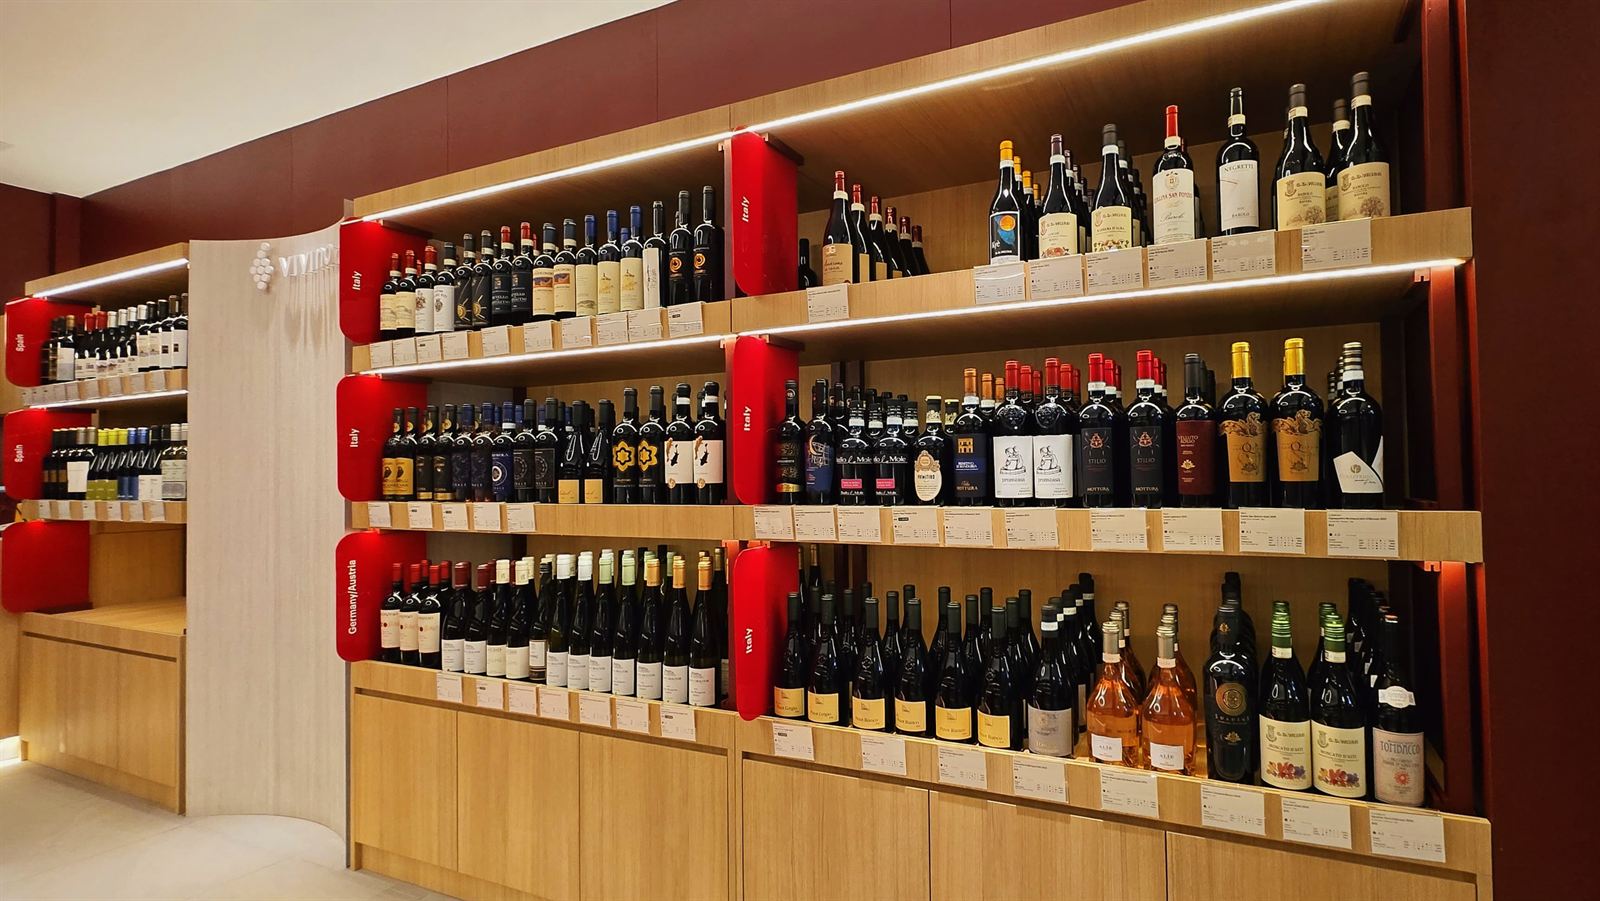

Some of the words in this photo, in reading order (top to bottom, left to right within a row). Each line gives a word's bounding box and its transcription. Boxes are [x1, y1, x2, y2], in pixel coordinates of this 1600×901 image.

[741, 196, 750, 222] Italy
[352, 270, 362, 291] Italy
[15, 334, 26, 352] Spain
[743, 406, 752, 431] Italy
[349, 428, 360, 448] Italy
[14, 444, 24, 463] Spain
[347, 560, 358, 635] Germany/Austria
[745, 628, 753, 654] Italy
[1379, 741, 1420, 756] TOMBACCO
